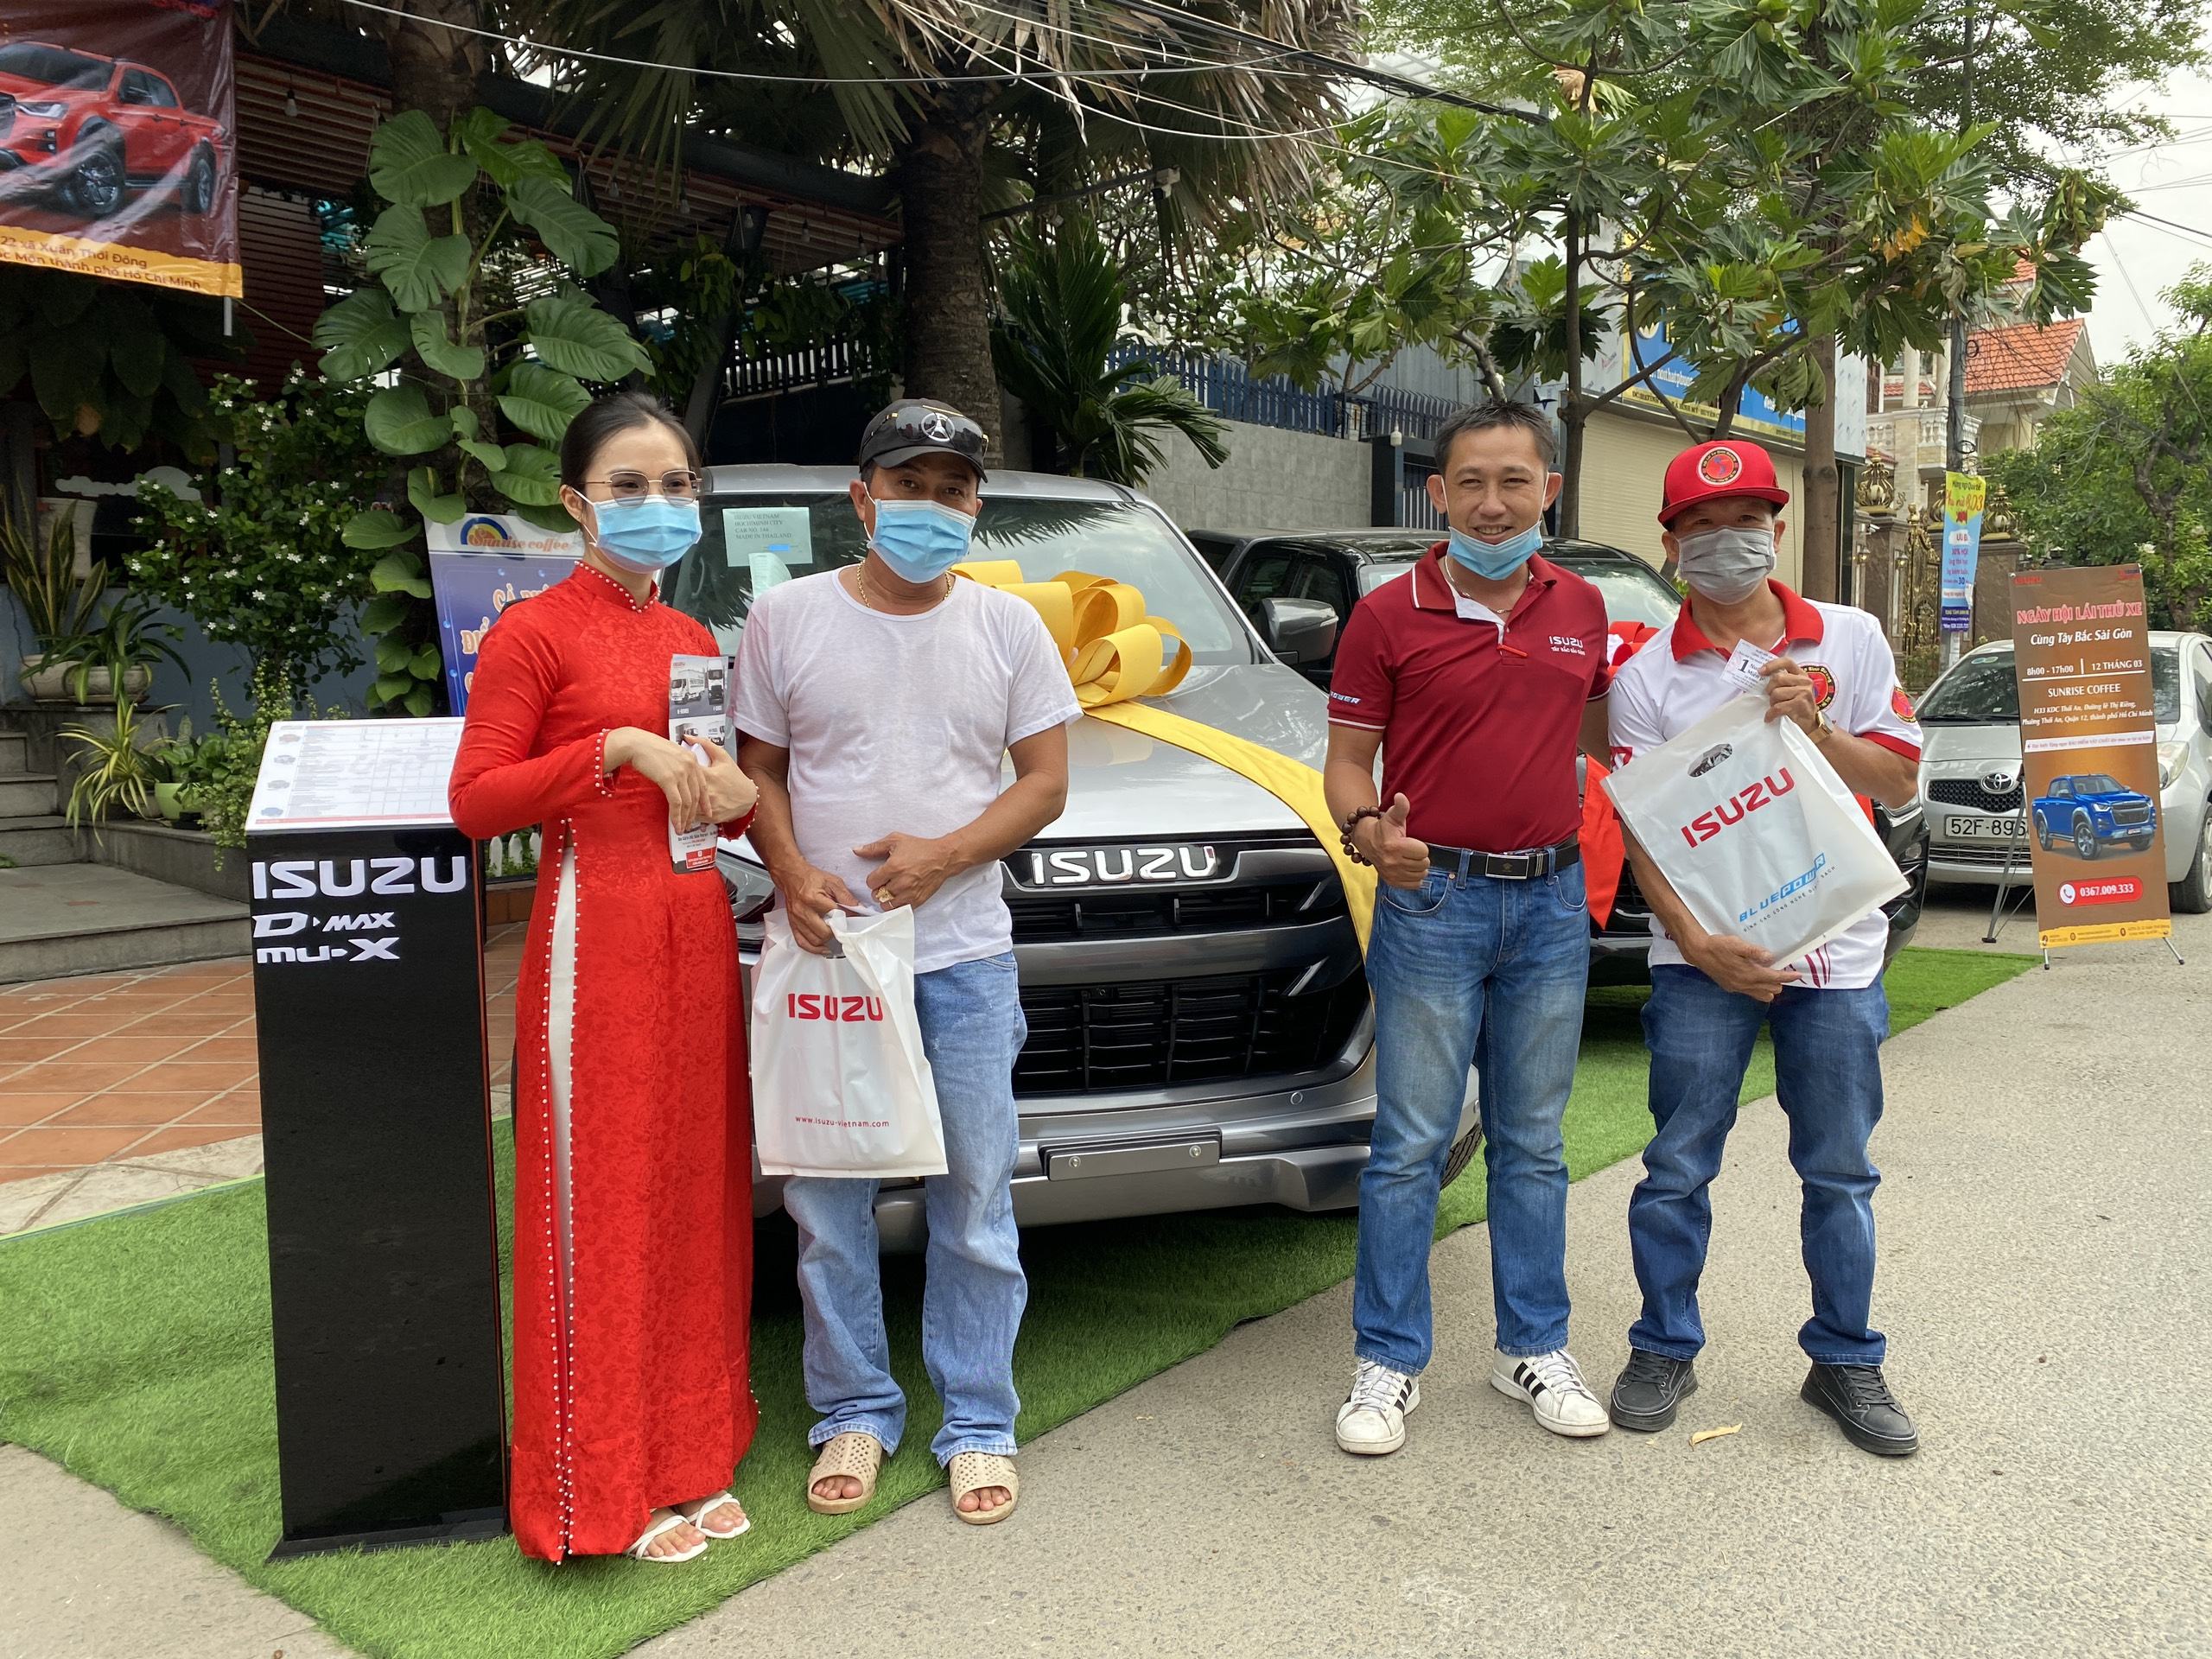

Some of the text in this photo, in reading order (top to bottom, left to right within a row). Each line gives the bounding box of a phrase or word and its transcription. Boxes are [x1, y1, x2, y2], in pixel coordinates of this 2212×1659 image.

[112, 252, 147, 269] Đông
[169, 276, 200, 289] Minh
[468, 527, 569, 552] Sunrise coffee
[2017, 600, 2143, 624] NGÀY HỘI LÁI THỬ XE
[1549, 636, 1583, 648] ISUZU
[2031, 628, 2133, 646] Cùng Tây Bắc Sài Gòn
[2027, 667, 2044, 676] 8h00
[2051, 665, 2074, 674] 17h00
[2103, 658, 2133, 670] THÁNG
[2048, 683, 2121, 698] SUNRISE COFFEE
[1681, 767, 1796, 849] ISUZU
[1031, 846, 1217, 885] ISUZU
[251, 855, 467, 899] ISUZU
[1739, 853, 1826, 922] BLUEPOWR
[2080, 883, 2134, 897] 0367.009.333
[257, 937, 400, 963] mu-X
[788, 994, 883, 1022] ISUZU
[795, 1116, 890, 1128] www.isuzu-vietnam.com
